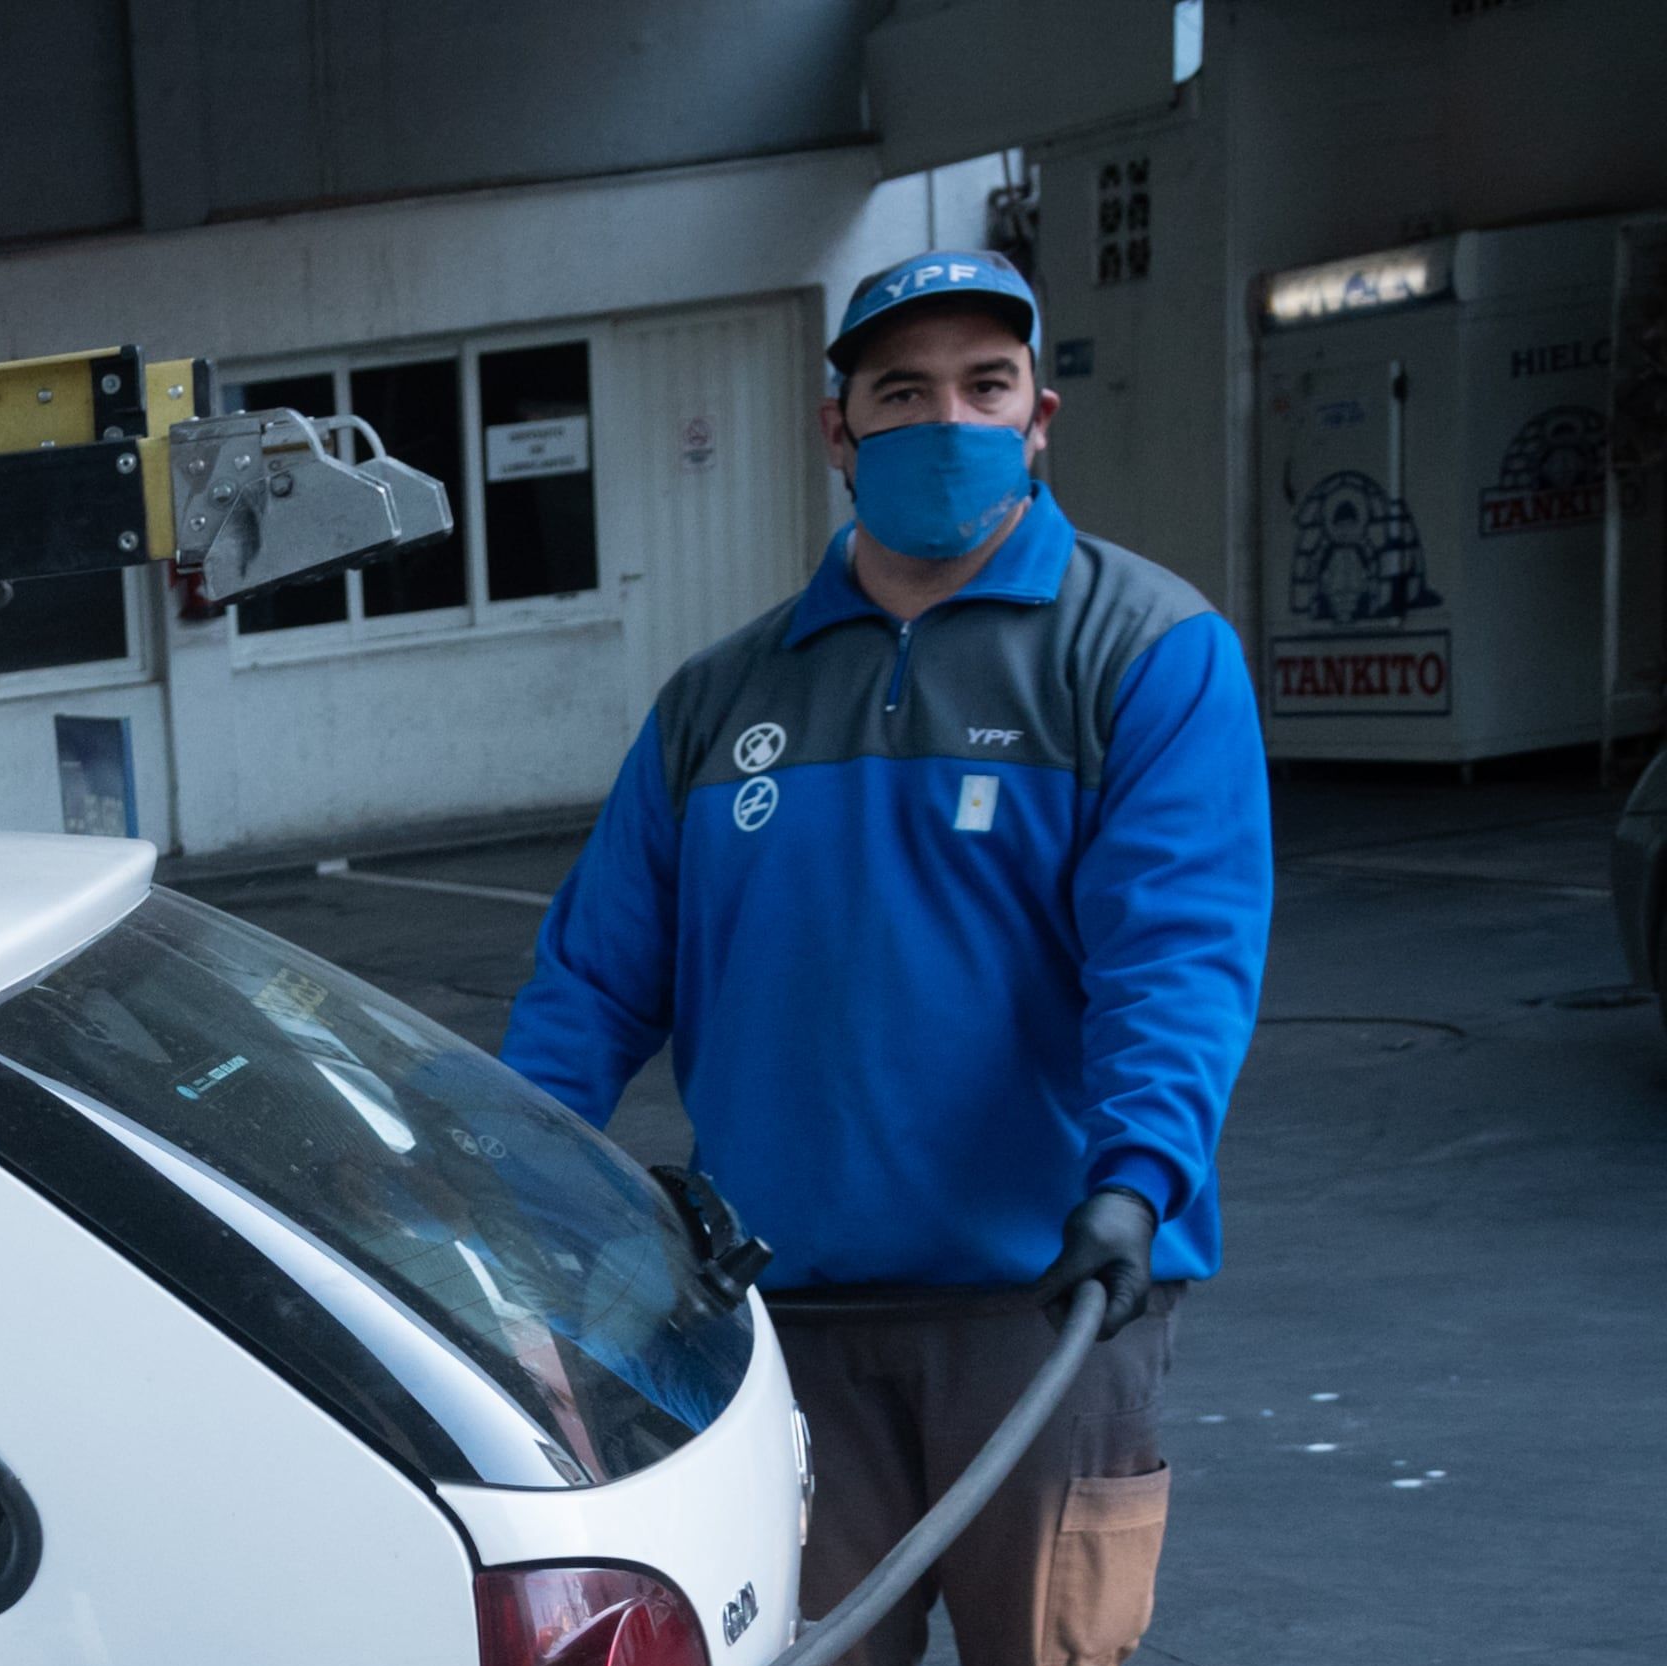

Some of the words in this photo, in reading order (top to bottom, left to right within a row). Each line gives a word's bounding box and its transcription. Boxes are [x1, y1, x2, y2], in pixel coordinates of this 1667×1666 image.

[885, 263, 978, 298] YPF
[1275, 653, 1446, 697] TANKITO
[967, 727, 1025, 747] YPF
